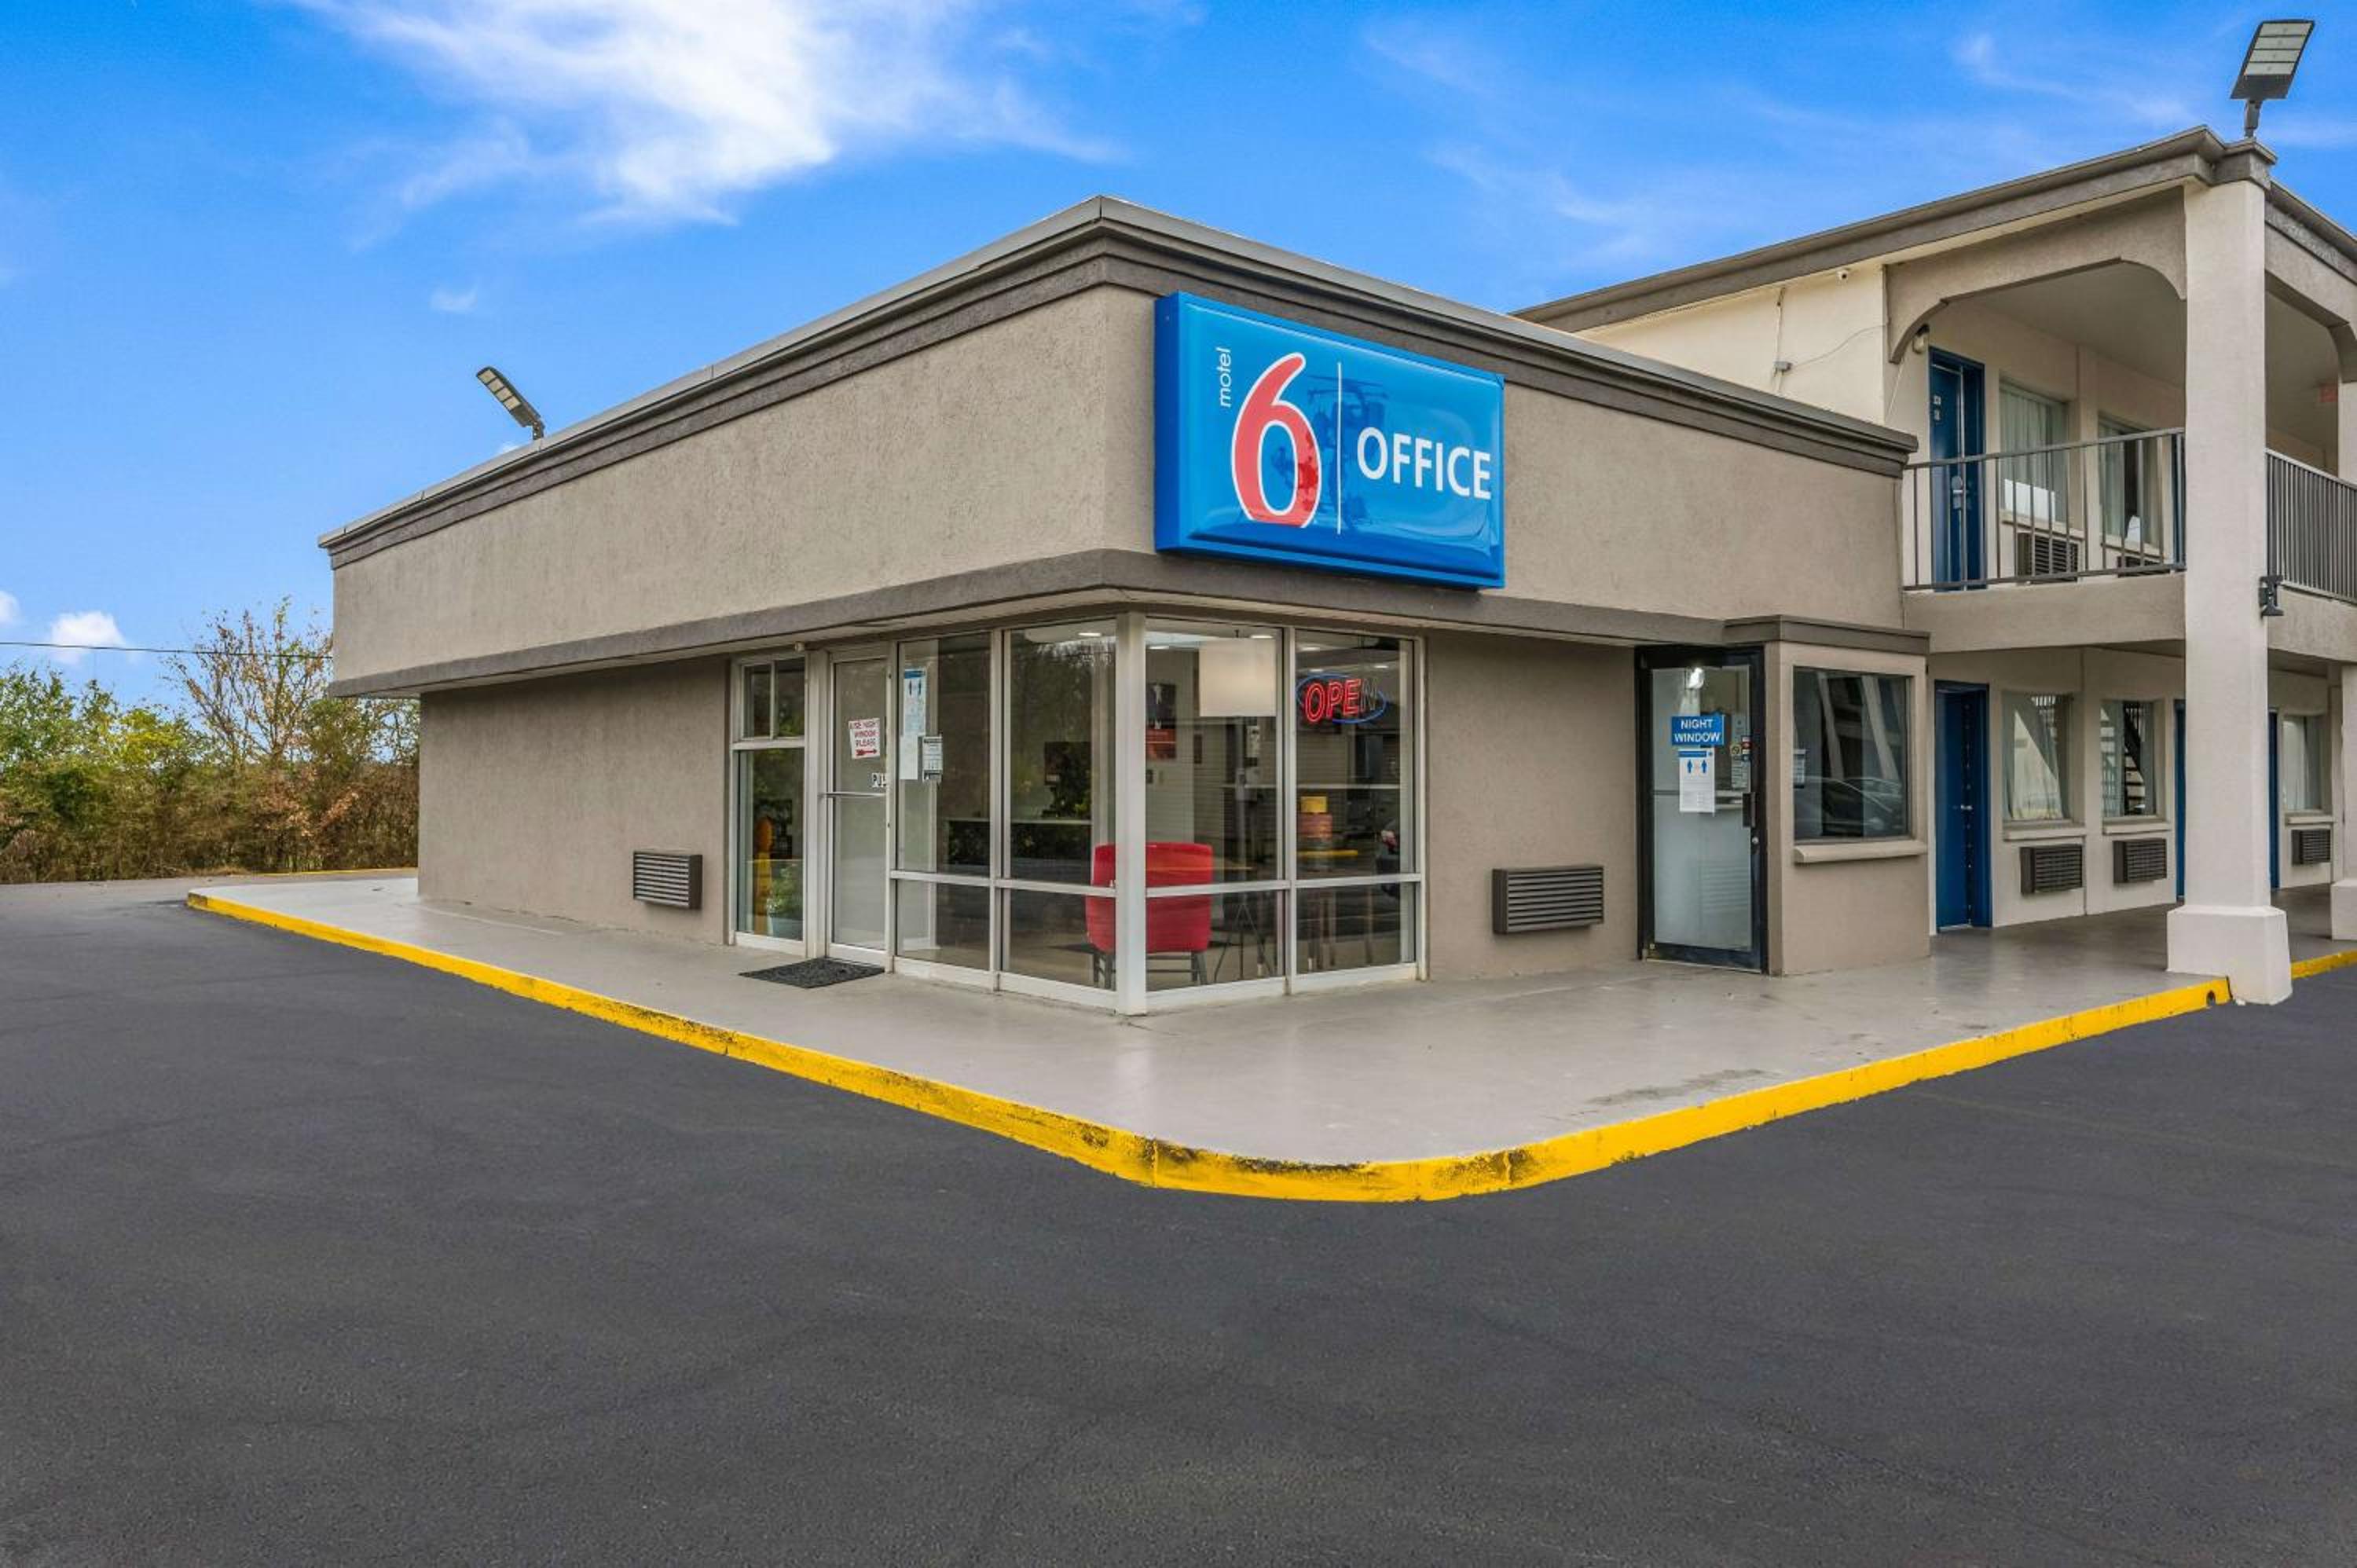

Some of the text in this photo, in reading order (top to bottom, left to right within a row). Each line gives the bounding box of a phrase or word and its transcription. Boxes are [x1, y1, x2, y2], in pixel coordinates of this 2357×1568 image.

[1216, 347, 1231, 407] motel
[1231, 352, 1321, 528] 6
[1357, 427, 1491, 499] OFFICE
[1674, 732, 1721, 742] WINDOW
[1681, 719, 1713, 729] NIGHT
